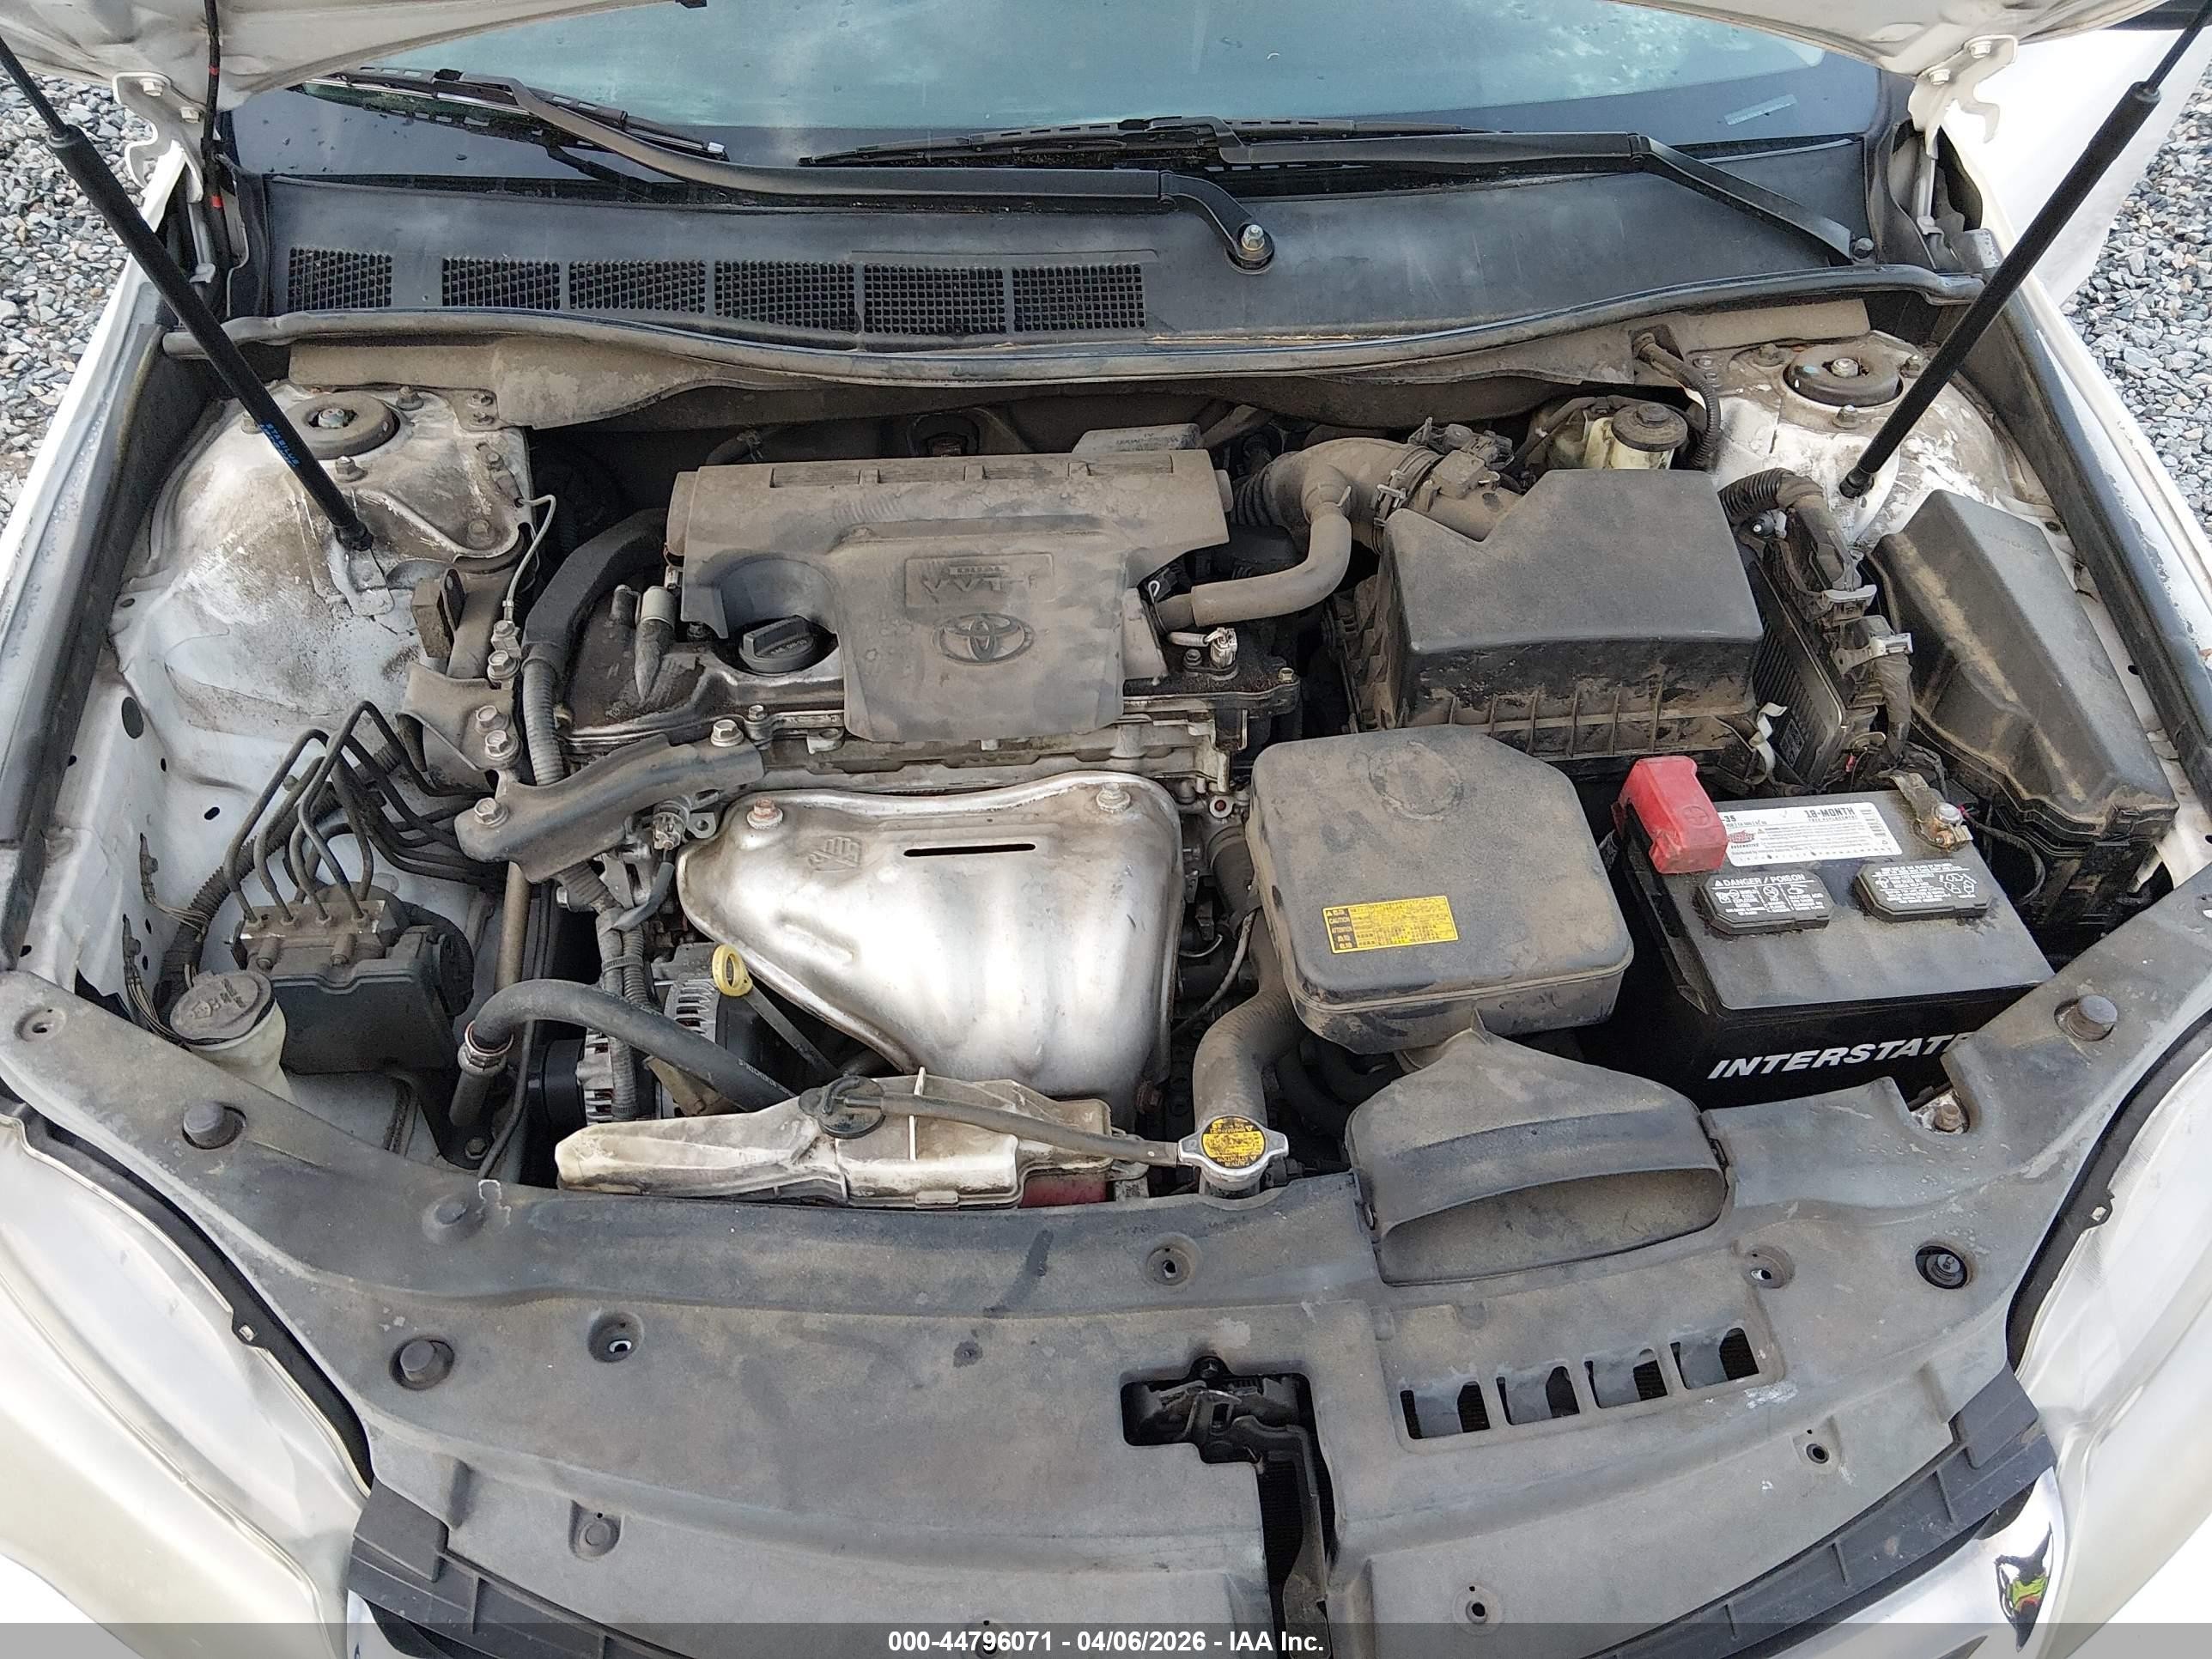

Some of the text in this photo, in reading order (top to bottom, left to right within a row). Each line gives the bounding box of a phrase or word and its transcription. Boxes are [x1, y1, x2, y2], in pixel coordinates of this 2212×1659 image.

[1804, 807, 1856, 817] 18-MONTH
[1724, 878, 1762, 886] DANGER
[1771, 873, 1805, 883] POISON
